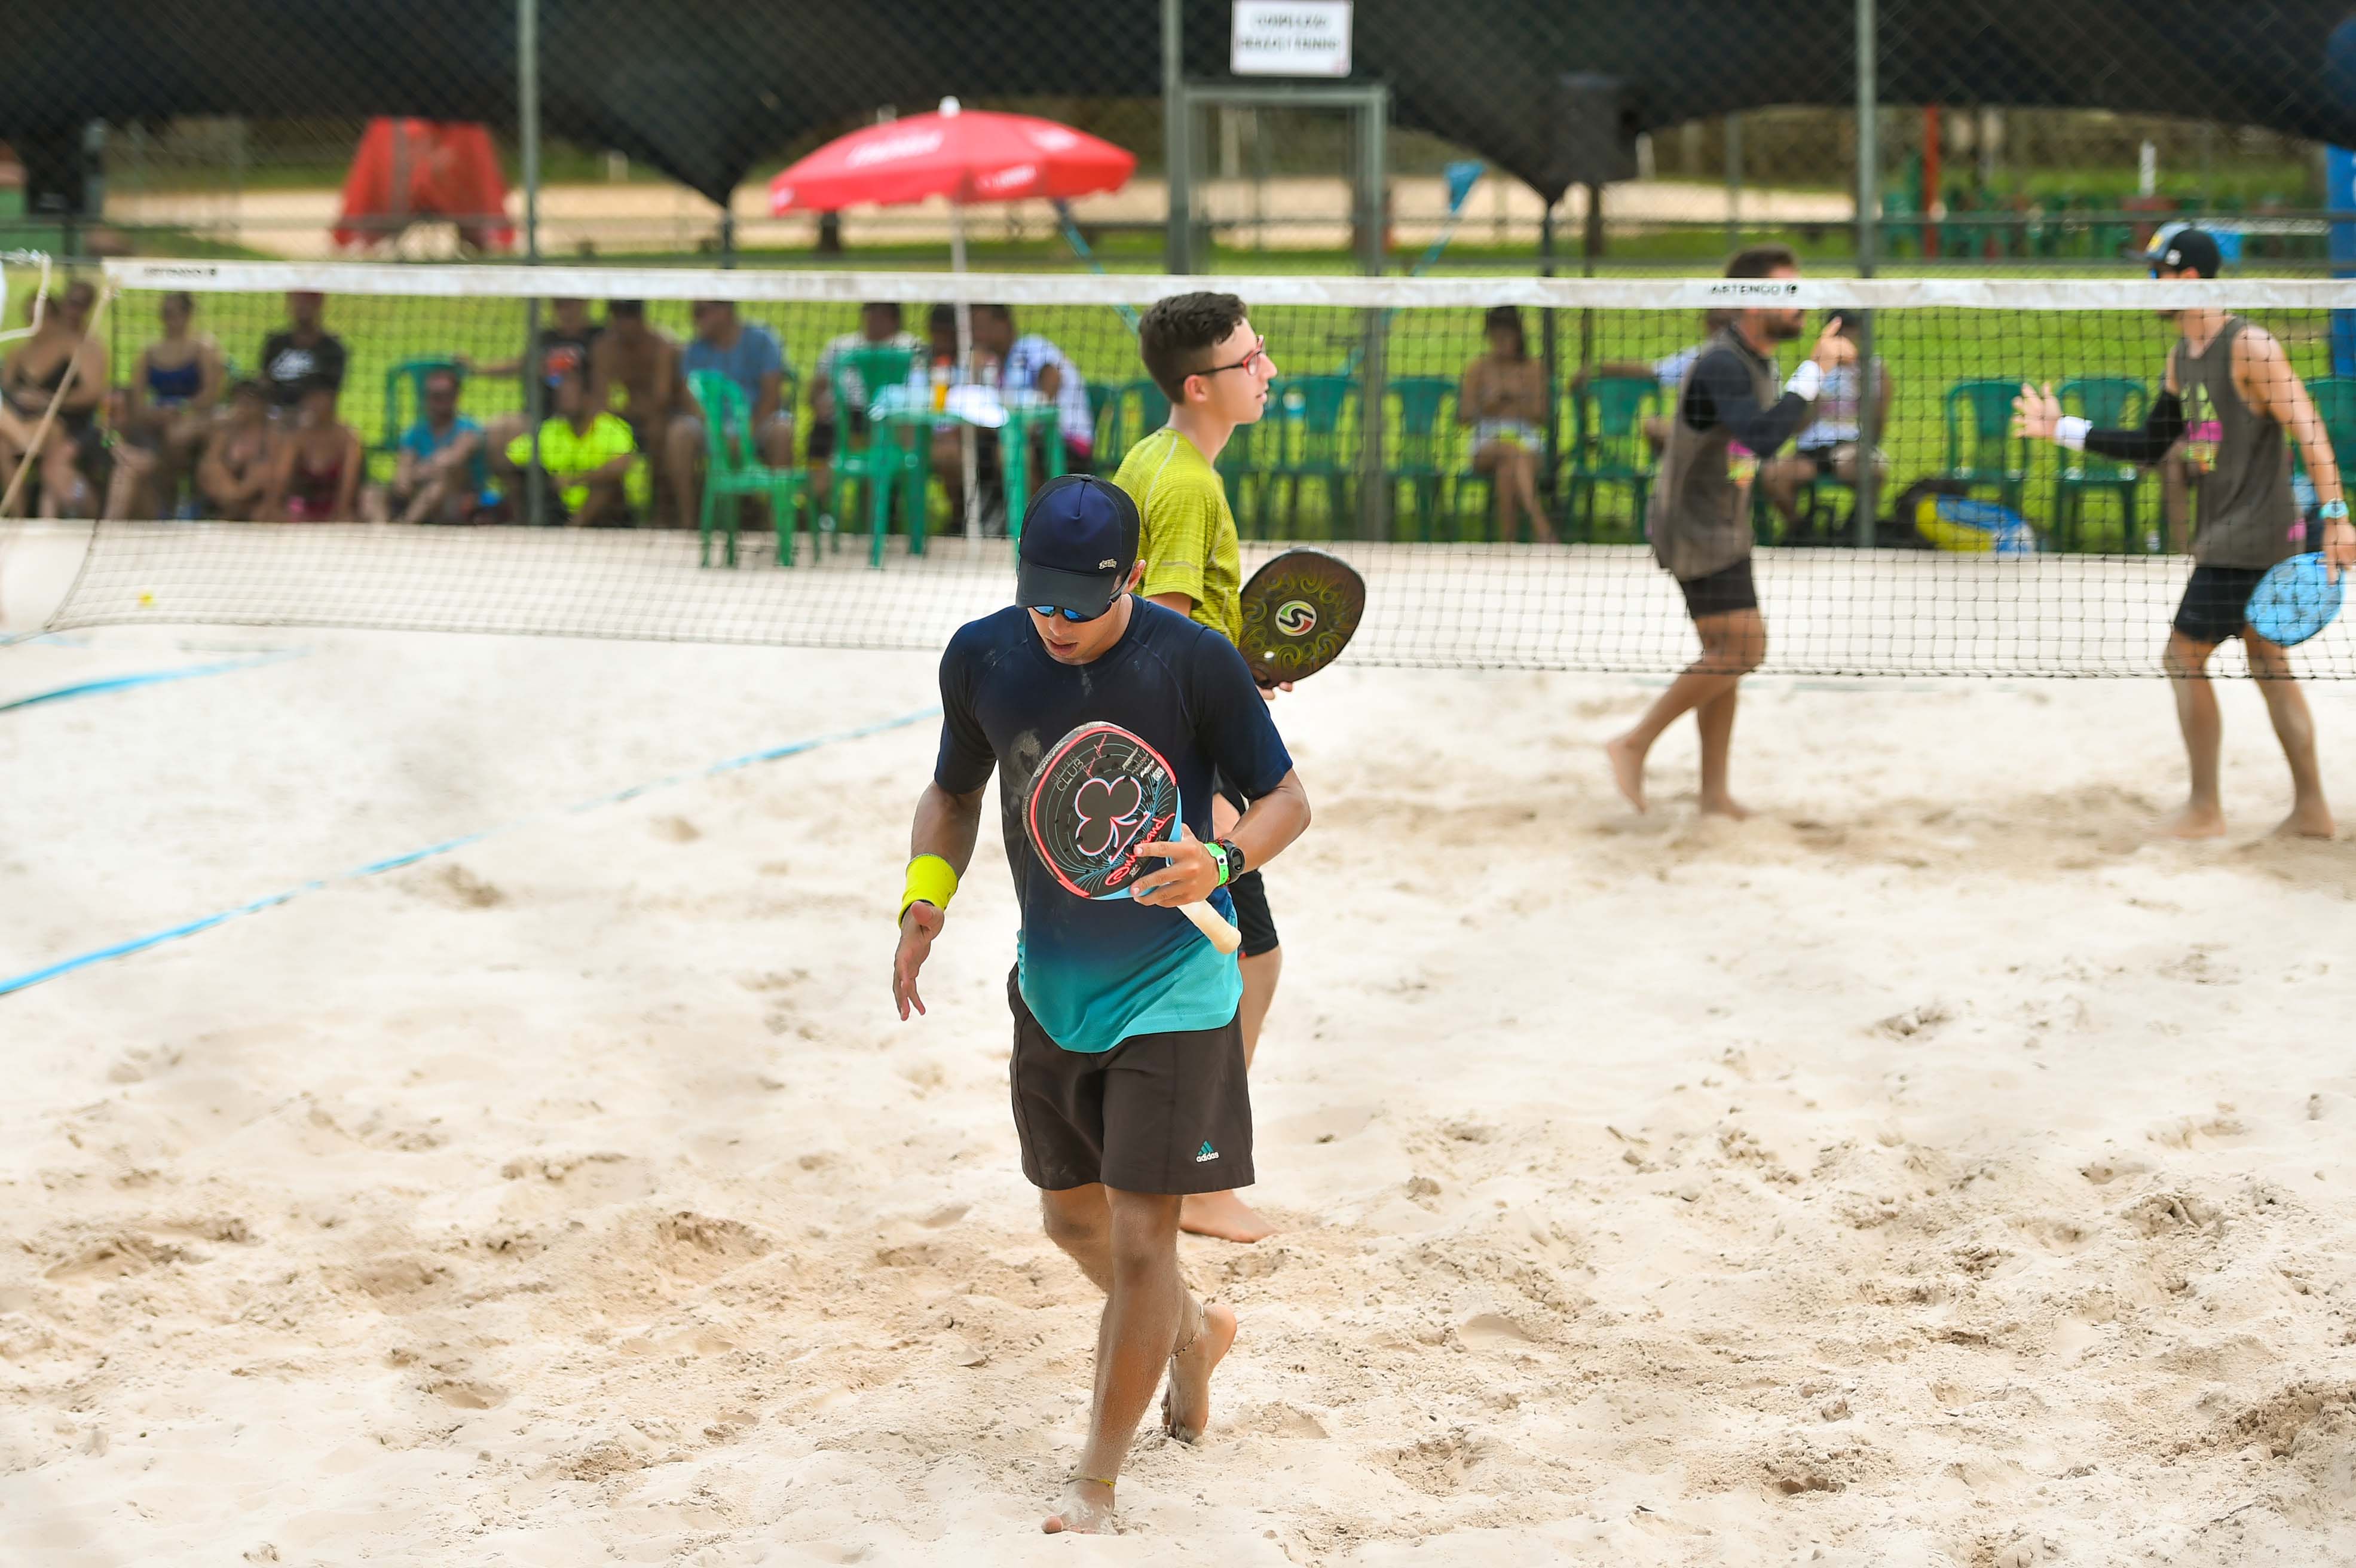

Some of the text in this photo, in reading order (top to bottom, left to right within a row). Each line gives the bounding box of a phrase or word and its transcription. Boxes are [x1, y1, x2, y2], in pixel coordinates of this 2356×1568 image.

[1050, 752, 1076, 784] SILVER
[1056, 758, 1084, 792] CLUB
[1196, 1152, 1219, 1162] adidas
